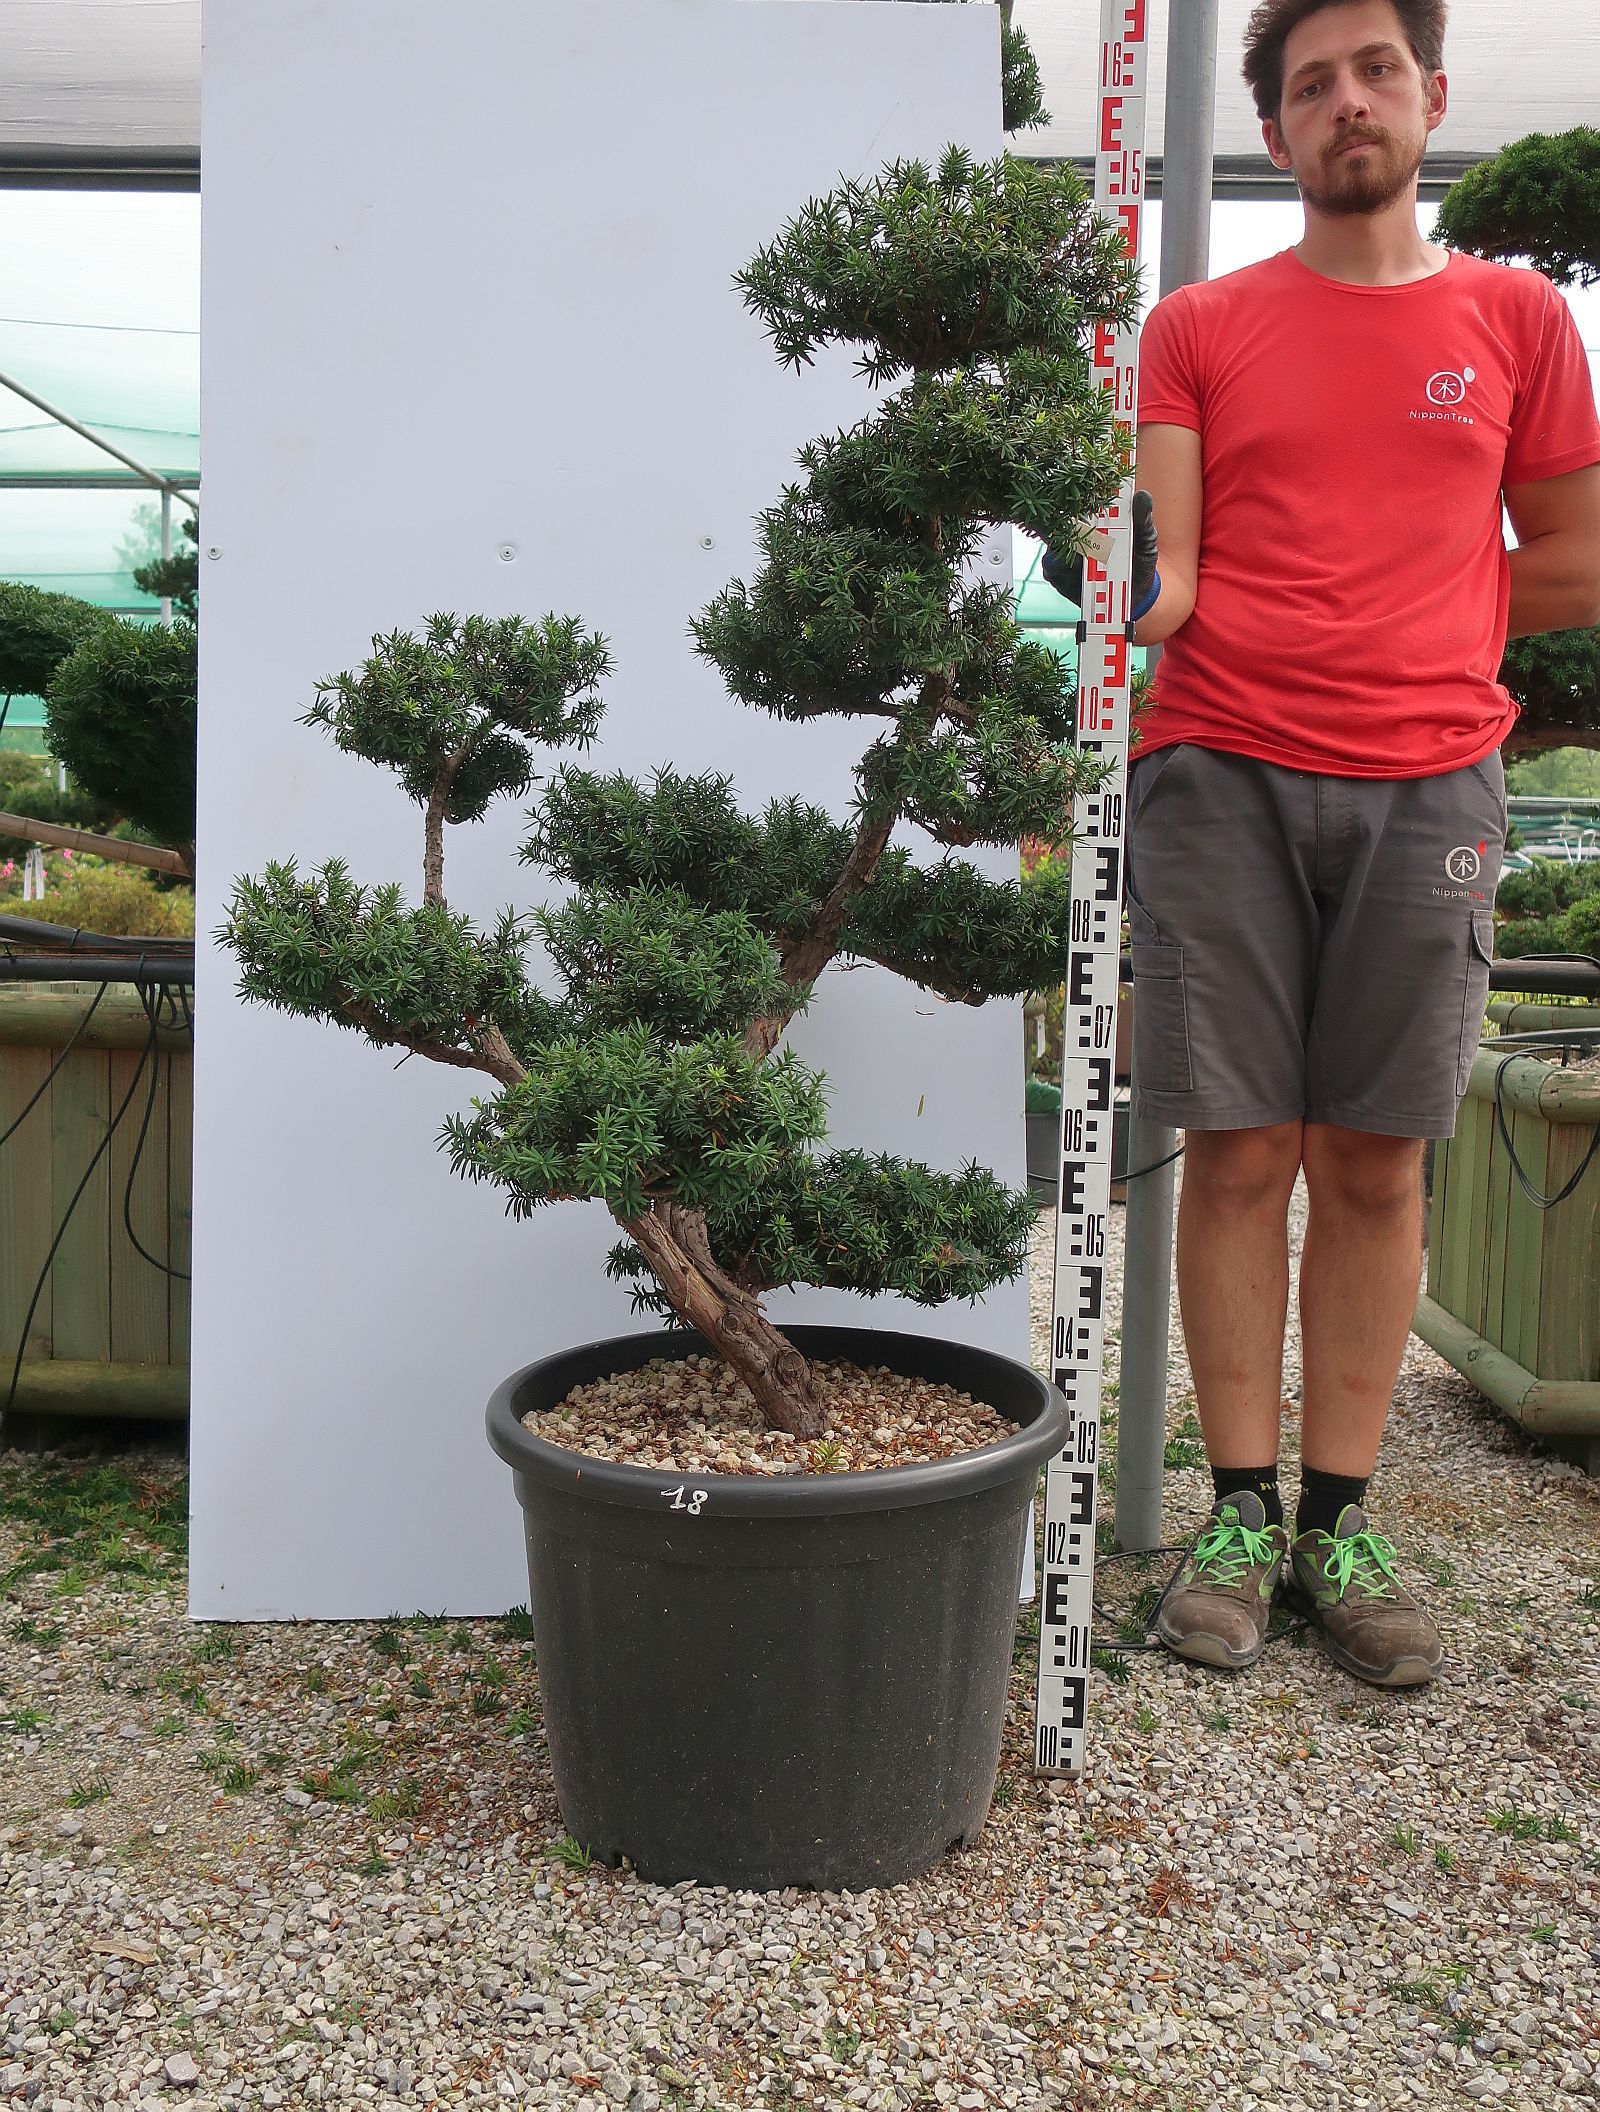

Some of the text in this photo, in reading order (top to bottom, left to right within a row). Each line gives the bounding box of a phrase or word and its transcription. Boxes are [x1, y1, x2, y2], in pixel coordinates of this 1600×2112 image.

[1102, 42, 1121, 87] 16
[1121, 150, 1141, 195] 15
[1114, 366, 1134, 411] 13
[1409, 409, 1474, 425] NipponTree
[1108, 580, 1127, 623] 11
[1079, 686, 1098, 730] 10
[1102, 793, 1122, 838] 09
[1071, 899, 1091, 942] 08
[1094, 1005, 1114, 1049] 07
[1063, 1109, 1083, 1152] 06
[1085, 1214, 1105, 1258] 05
[1055, 1316, 1074, 1360] 04
[1077, 1420, 1097, 1464] 03
[660, 1484, 709, 1516] 18
[1047, 1521, 1066, 1565] 02
[1069, 1625, 1088, 1669] 01
[1039, 1725, 1058, 1768] 00
